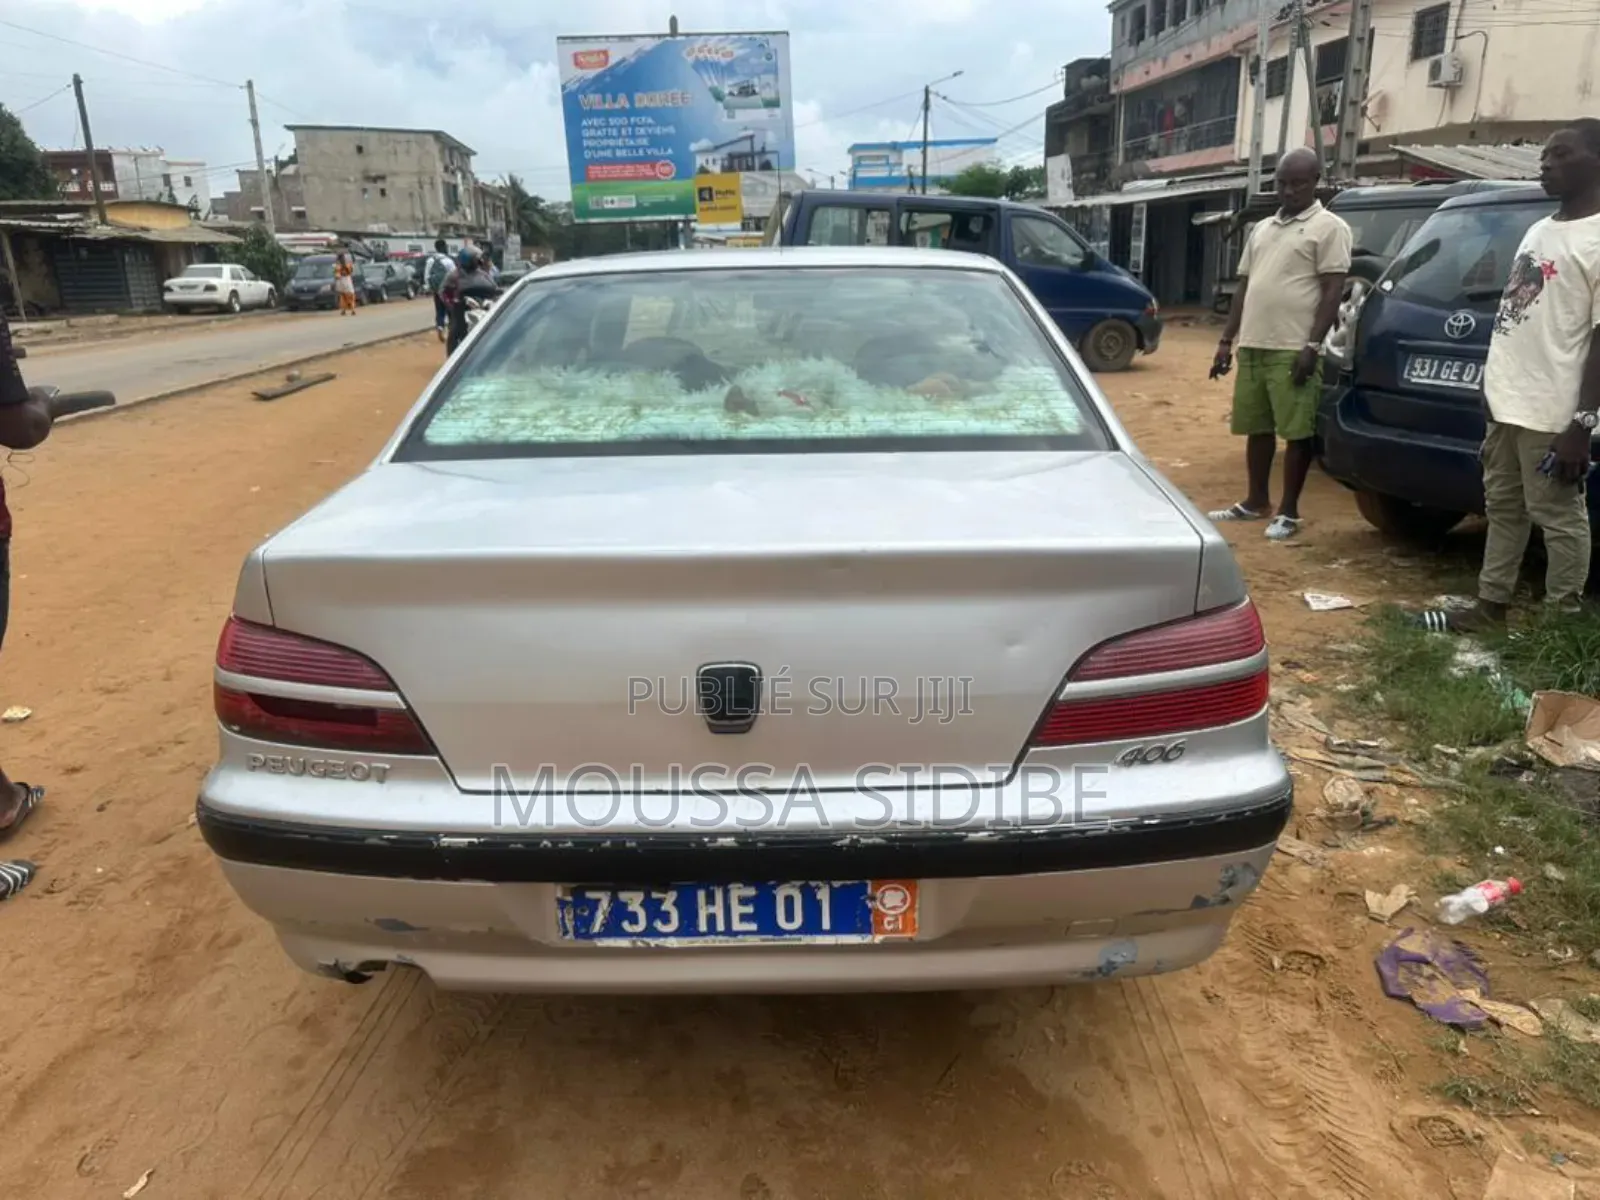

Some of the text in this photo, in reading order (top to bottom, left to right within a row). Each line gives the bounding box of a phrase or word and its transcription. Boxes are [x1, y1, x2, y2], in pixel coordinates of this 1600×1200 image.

[578, 92, 630, 109] VILLA
[581, 117, 607, 127] AVEC
[608, 117, 629, 126] 500
[581, 126, 676, 137] GRATTE ET DEVIENS
[616, 147, 644, 157] BELLE
[646, 146, 674, 156] VILLA
[1441, 360, 1463, 380] GE
[1115, 738, 1187, 767] 406
[247, 753, 391, 783] PEUGEOT
[584, 884, 831, 933] 733 HE 01
